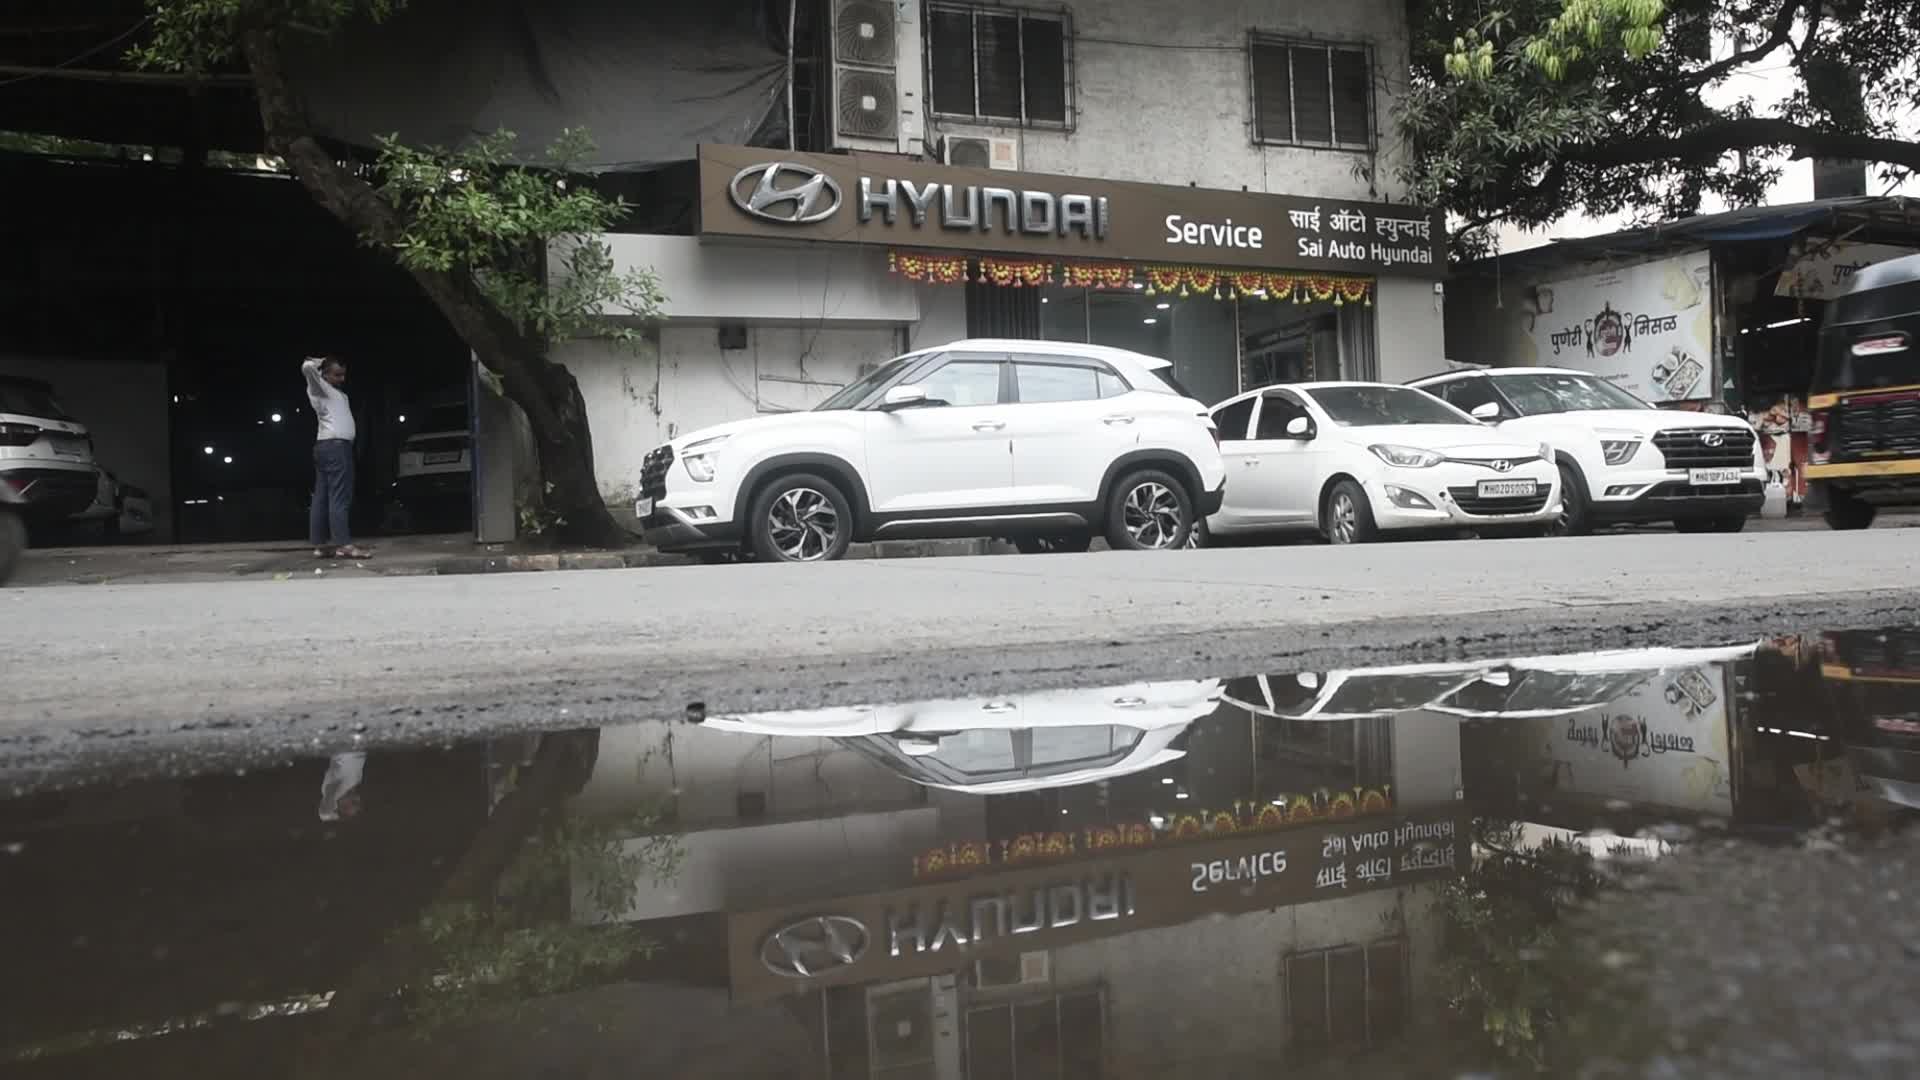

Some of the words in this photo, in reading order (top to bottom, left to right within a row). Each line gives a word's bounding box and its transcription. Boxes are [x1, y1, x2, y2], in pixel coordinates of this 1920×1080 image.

[857, 176, 1109, 239] HYUNDAI
[1288, 205, 1321, 232] साई
[1329, 209, 1366, 233] ऑटो
[1165, 214, 1263, 249] Service
[1298, 237, 1323, 257] Sai
[1328, 241, 1365, 260] Auto
[1371, 243, 1433, 265] Hyundai
[1550, 324, 1582, 355] पुणेरी
[1634, 314, 1678, 336] मिसळ
